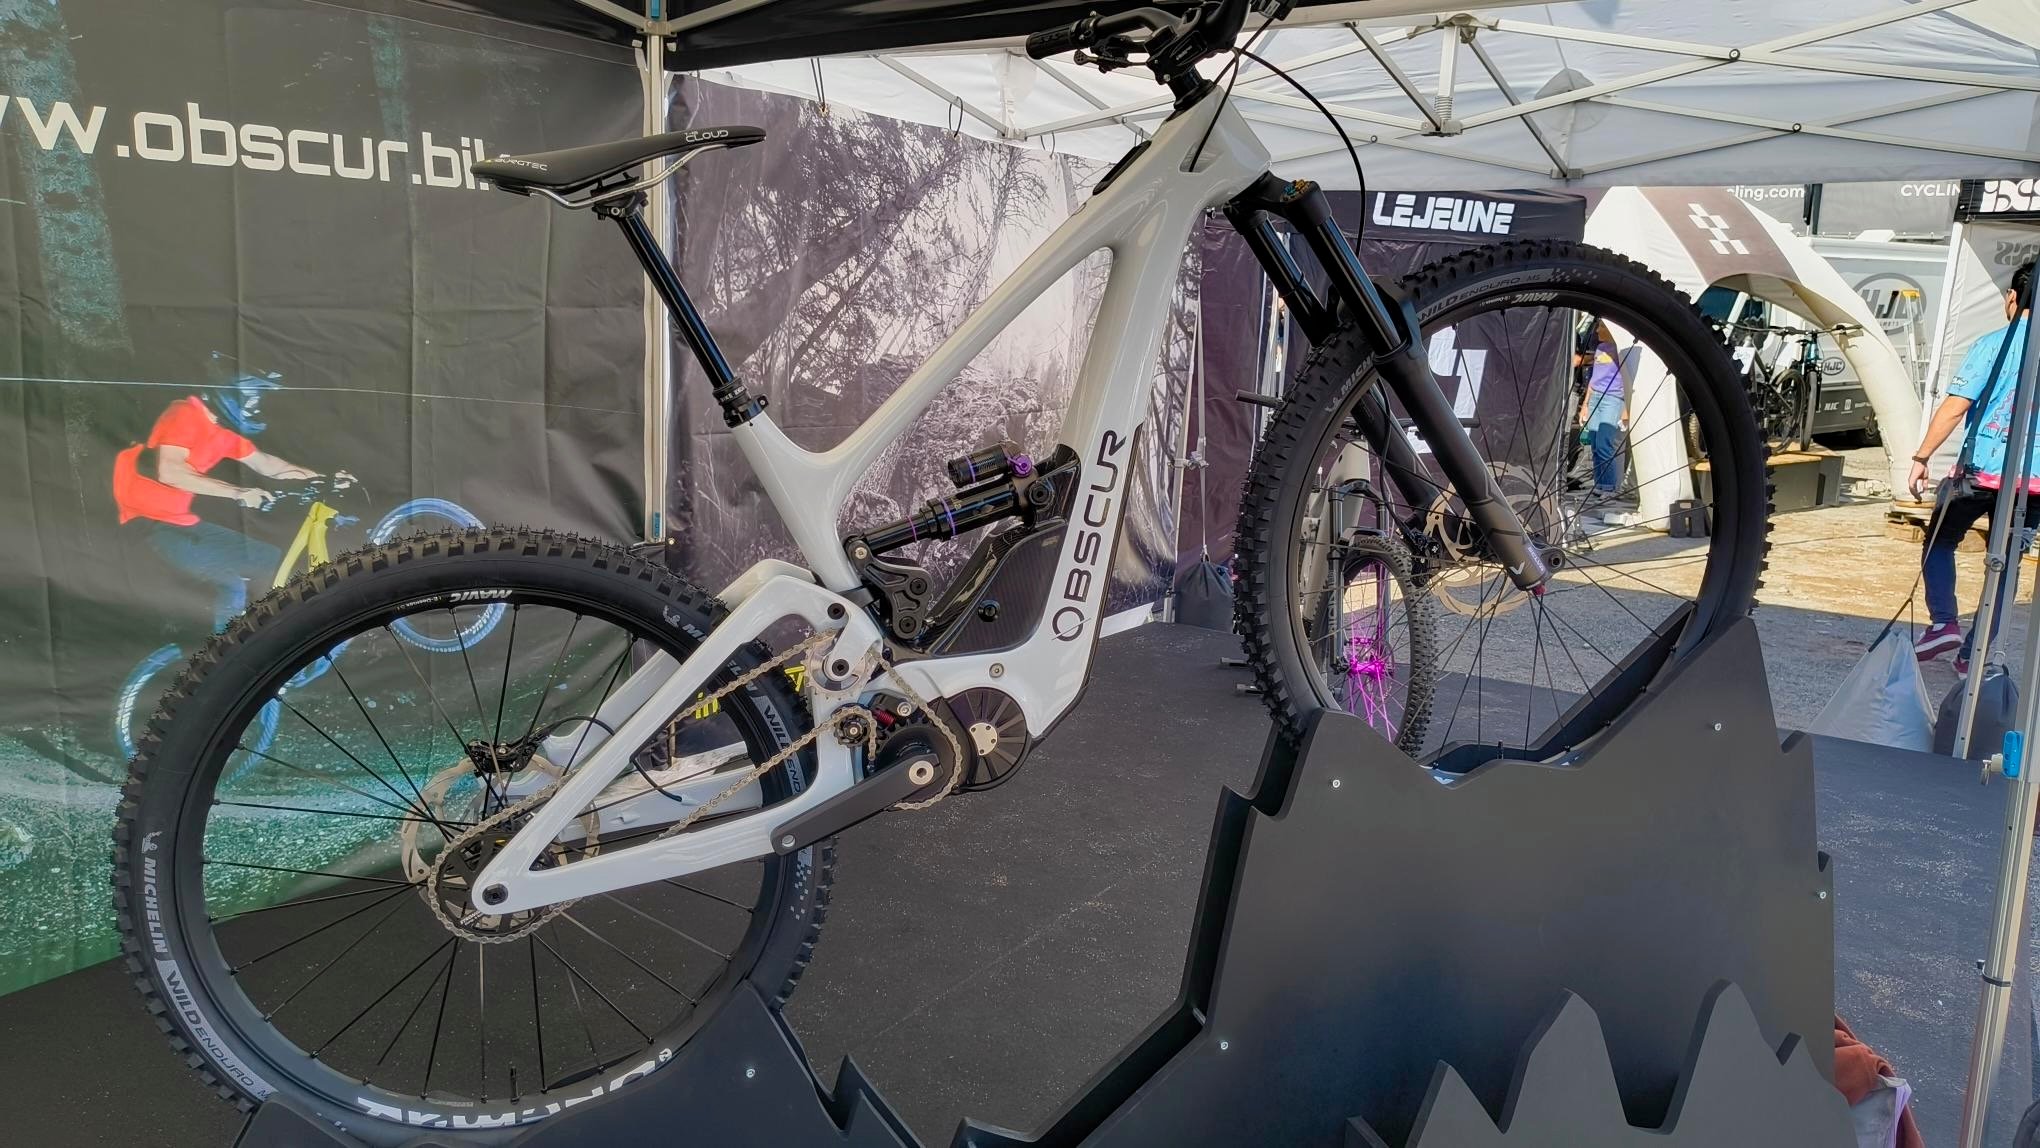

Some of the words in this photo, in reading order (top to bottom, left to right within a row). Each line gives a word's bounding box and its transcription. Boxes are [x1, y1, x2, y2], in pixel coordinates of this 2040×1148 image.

[0, 95, 489, 191] w.obscur.bi
[686, 130, 728, 142] CLOUD
[1373, 192, 1515, 235] LEJEUNE
[1461, 277, 1520, 300] ENDURO
[1511, 292, 1558, 304] MAVIC
[1052, 429, 1127, 642] OBSCUR
[449, 589, 513, 603] MAVIC
[787, 759, 801, 793] END
[144, 856, 168, 953] MICHELIN
[167, 970, 201, 1025] WILD
[194, 1027, 255, 1087] ENDURO
